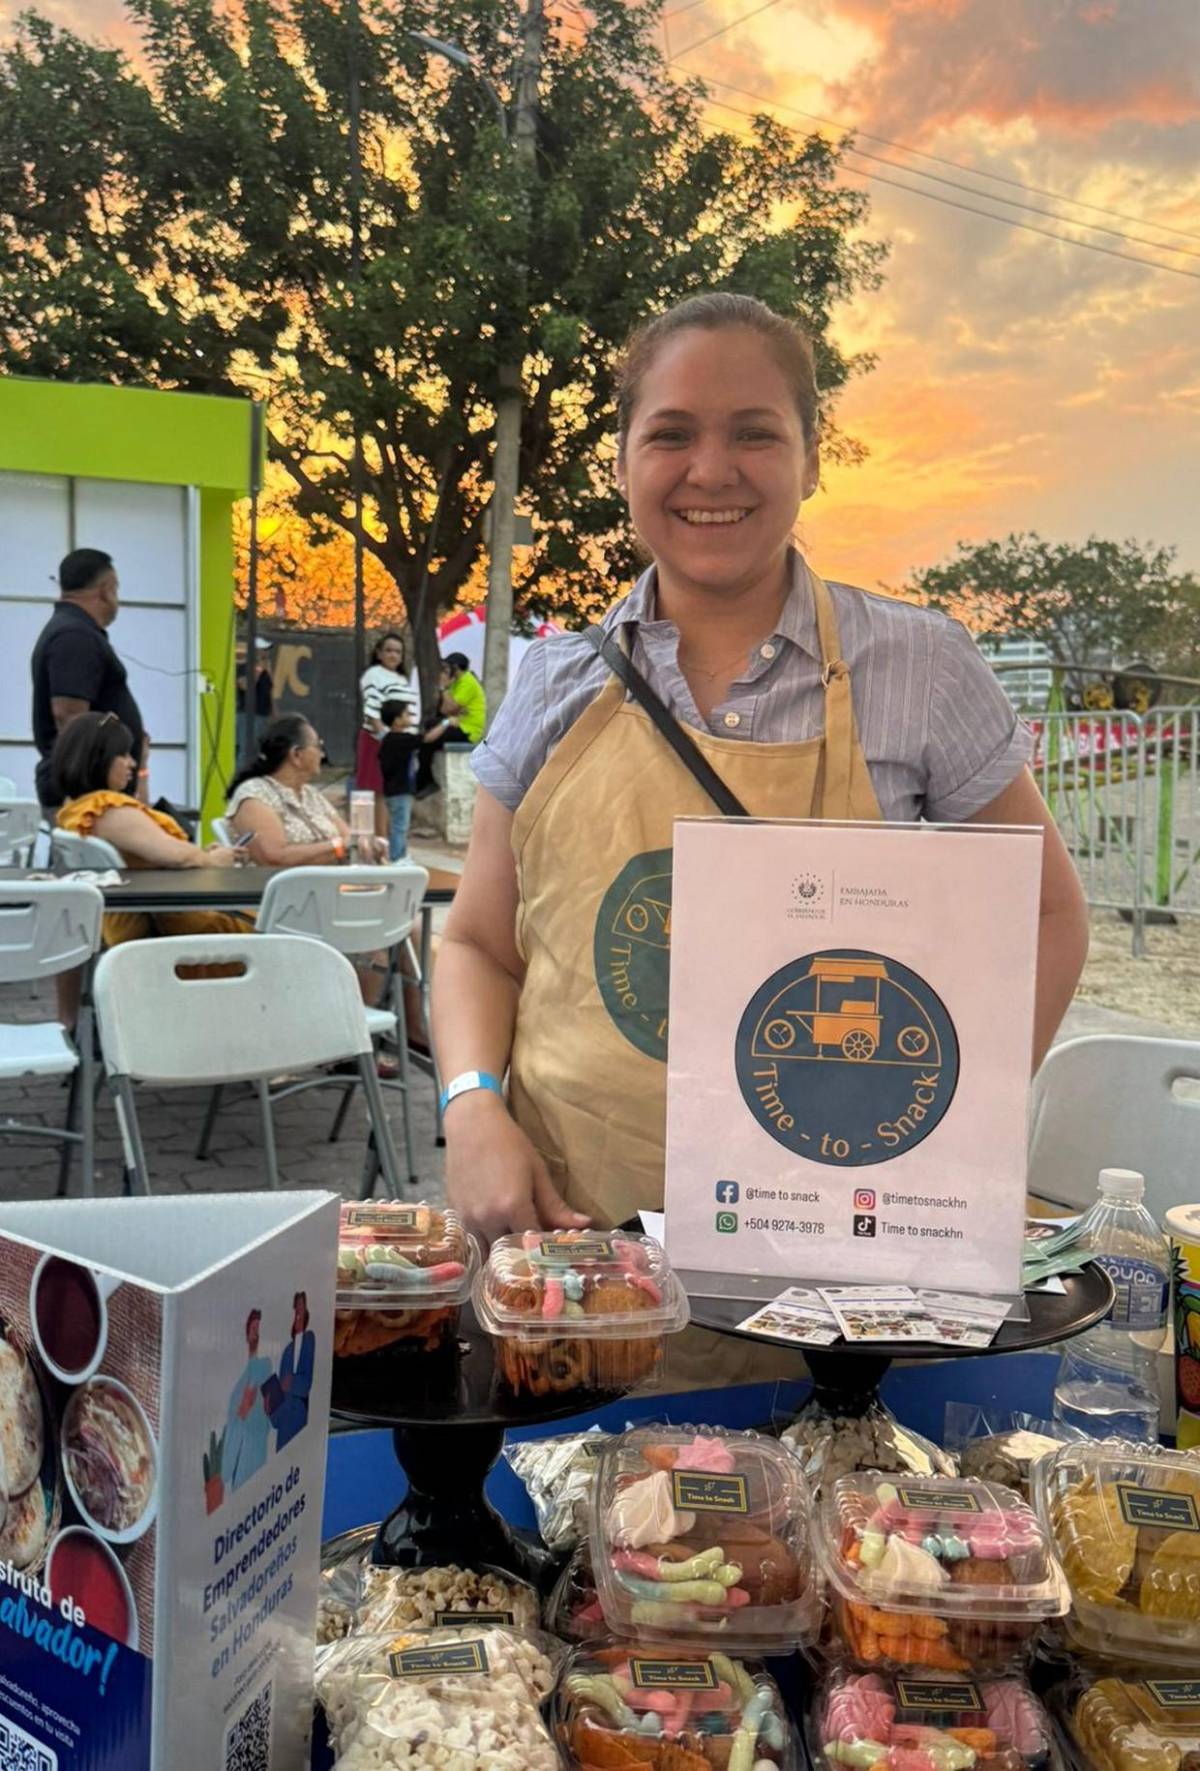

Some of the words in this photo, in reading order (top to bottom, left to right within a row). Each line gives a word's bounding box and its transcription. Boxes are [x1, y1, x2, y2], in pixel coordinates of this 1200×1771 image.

[610, 943, 637, 1010] Time
[753, 1062, 795, 1131] Time
[820, 1133, 850, 1158] to
[877, 1071, 940, 1147] Snack
[744, 1218, 769, 1230] +504
[771, 1219, 825, 1235] 9274-3978
[745, 1187, 777, 1200] @time
[778, 1190, 789, 1201] to
[790, 1191, 820, 1203] snack
[882, 1192, 968, 1209] @timetosnackhn
[881, 1222, 905, 1236] Time
[908, 1225, 918, 1236] to
[920, 1226, 964, 1239] snackhn
[213, 1483, 283, 1566] Directorio
[284, 1466, 301, 1493] de
[202, 1492, 306, 1614] Emprendedores
[60, 1595, 86, 1628] de
[210, 1533, 298, 1643] Salvadoreños
[211, 1644, 230, 1680] en
[233, 1571, 294, 1657] Honduras
